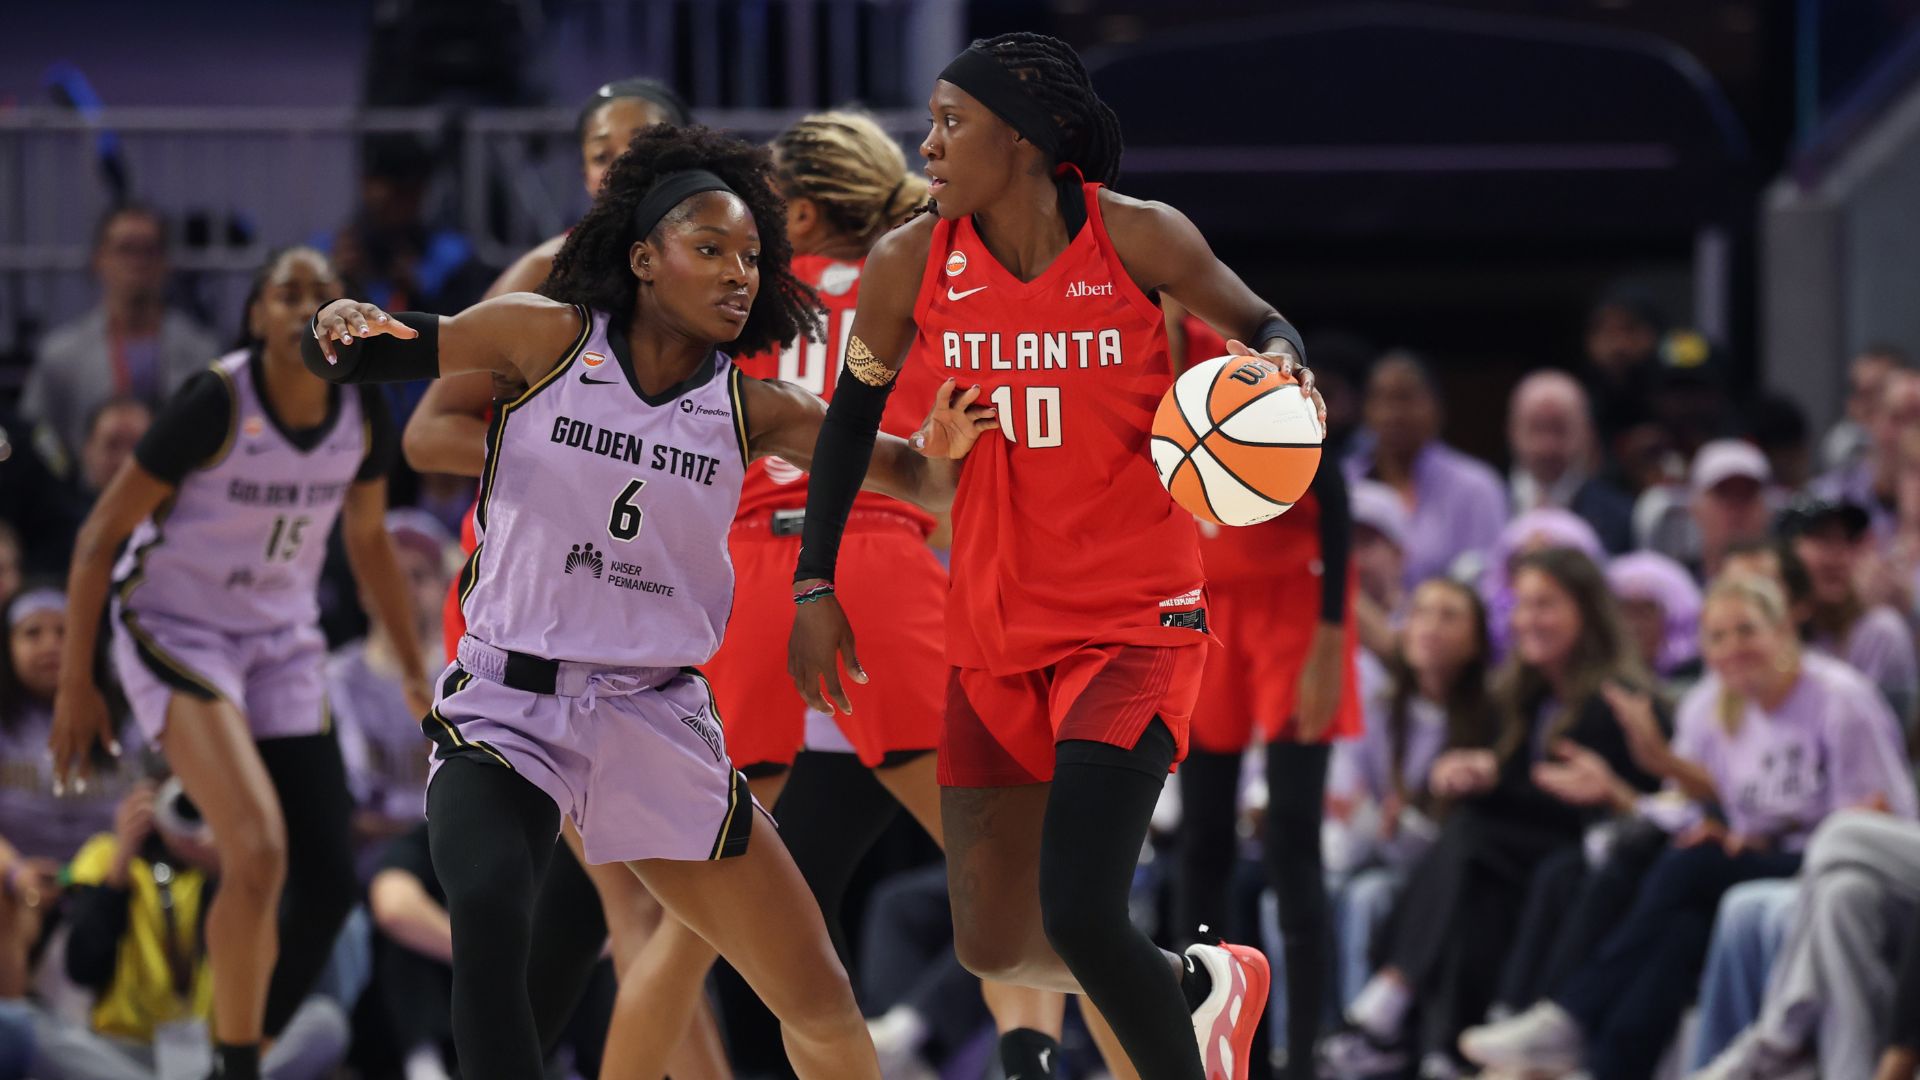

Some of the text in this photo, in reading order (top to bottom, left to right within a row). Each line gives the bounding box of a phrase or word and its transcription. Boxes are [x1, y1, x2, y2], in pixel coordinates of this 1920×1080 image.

[1065, 280, 1113, 298] Albert
[943, 328, 1122, 370] ATLANTA
[694, 404, 731, 418] freedom
[990, 385, 1063, 449] 10
[550, 415, 721, 486] GOLDEN STATE
[607, 477, 647, 543] 6
[265, 514, 311, 562] 15
